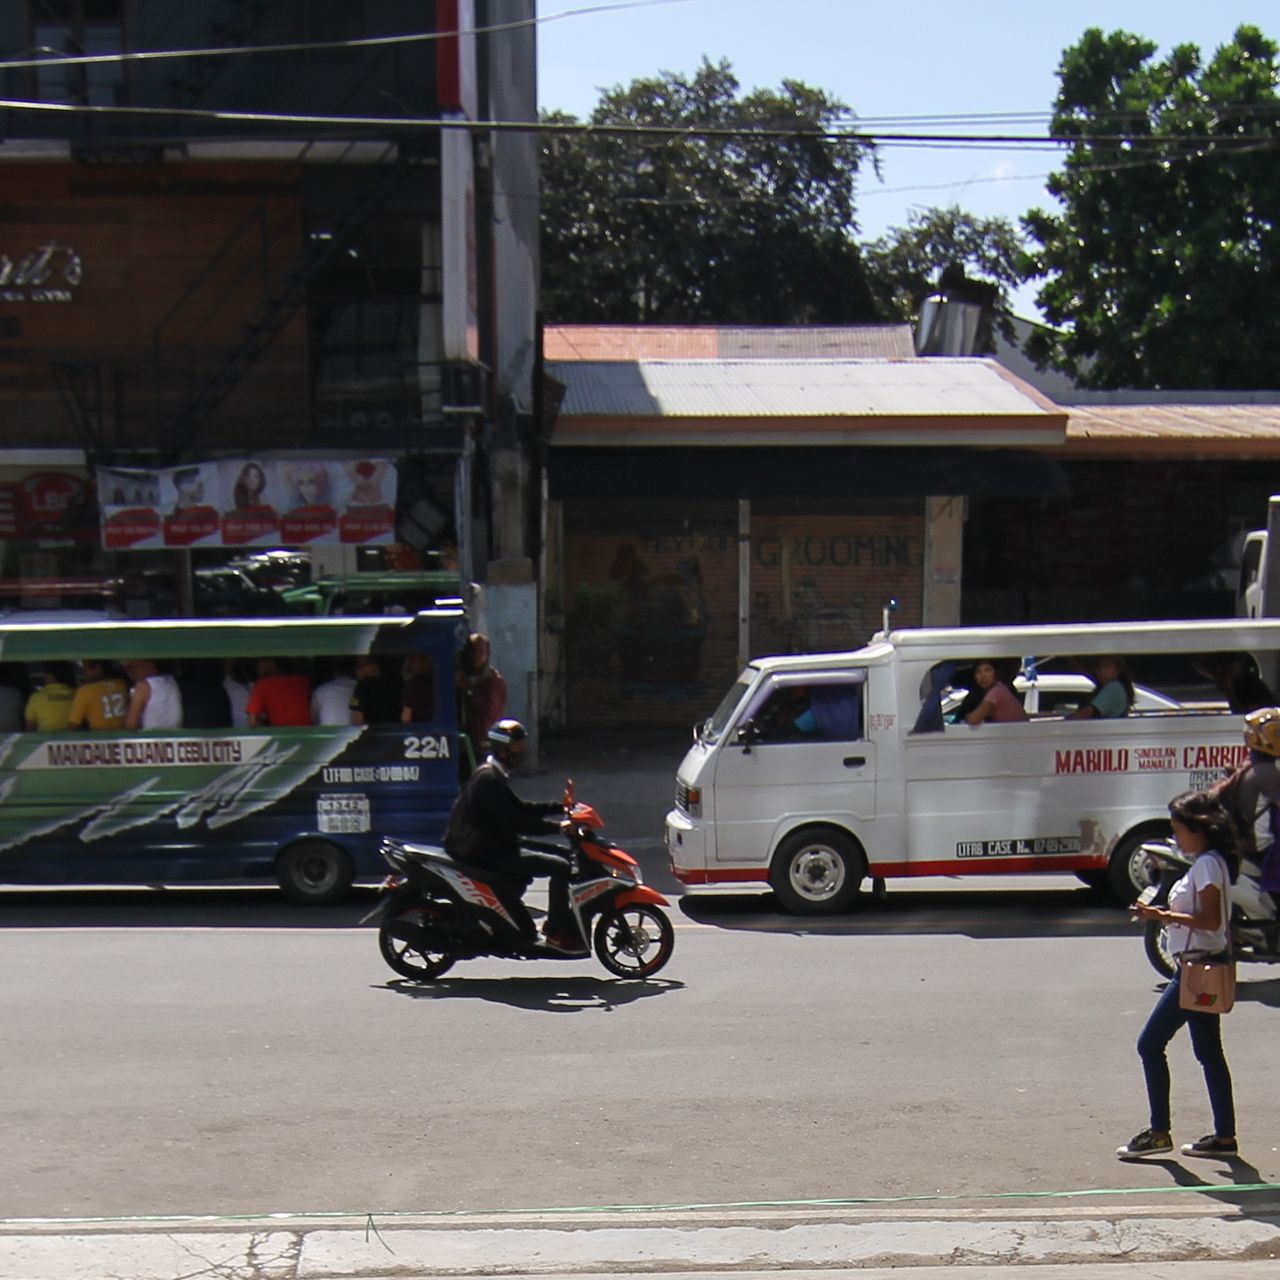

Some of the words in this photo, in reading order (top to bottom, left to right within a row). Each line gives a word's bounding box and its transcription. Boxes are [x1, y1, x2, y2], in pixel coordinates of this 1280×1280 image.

[47, 743, 121, 766] MANDAUE
[178, 741, 210, 763] CEBU
[212, 740, 242, 762] CITY
[1055, 750, 1128, 775] MABOLO
[987, 840, 1012, 855] CASE
